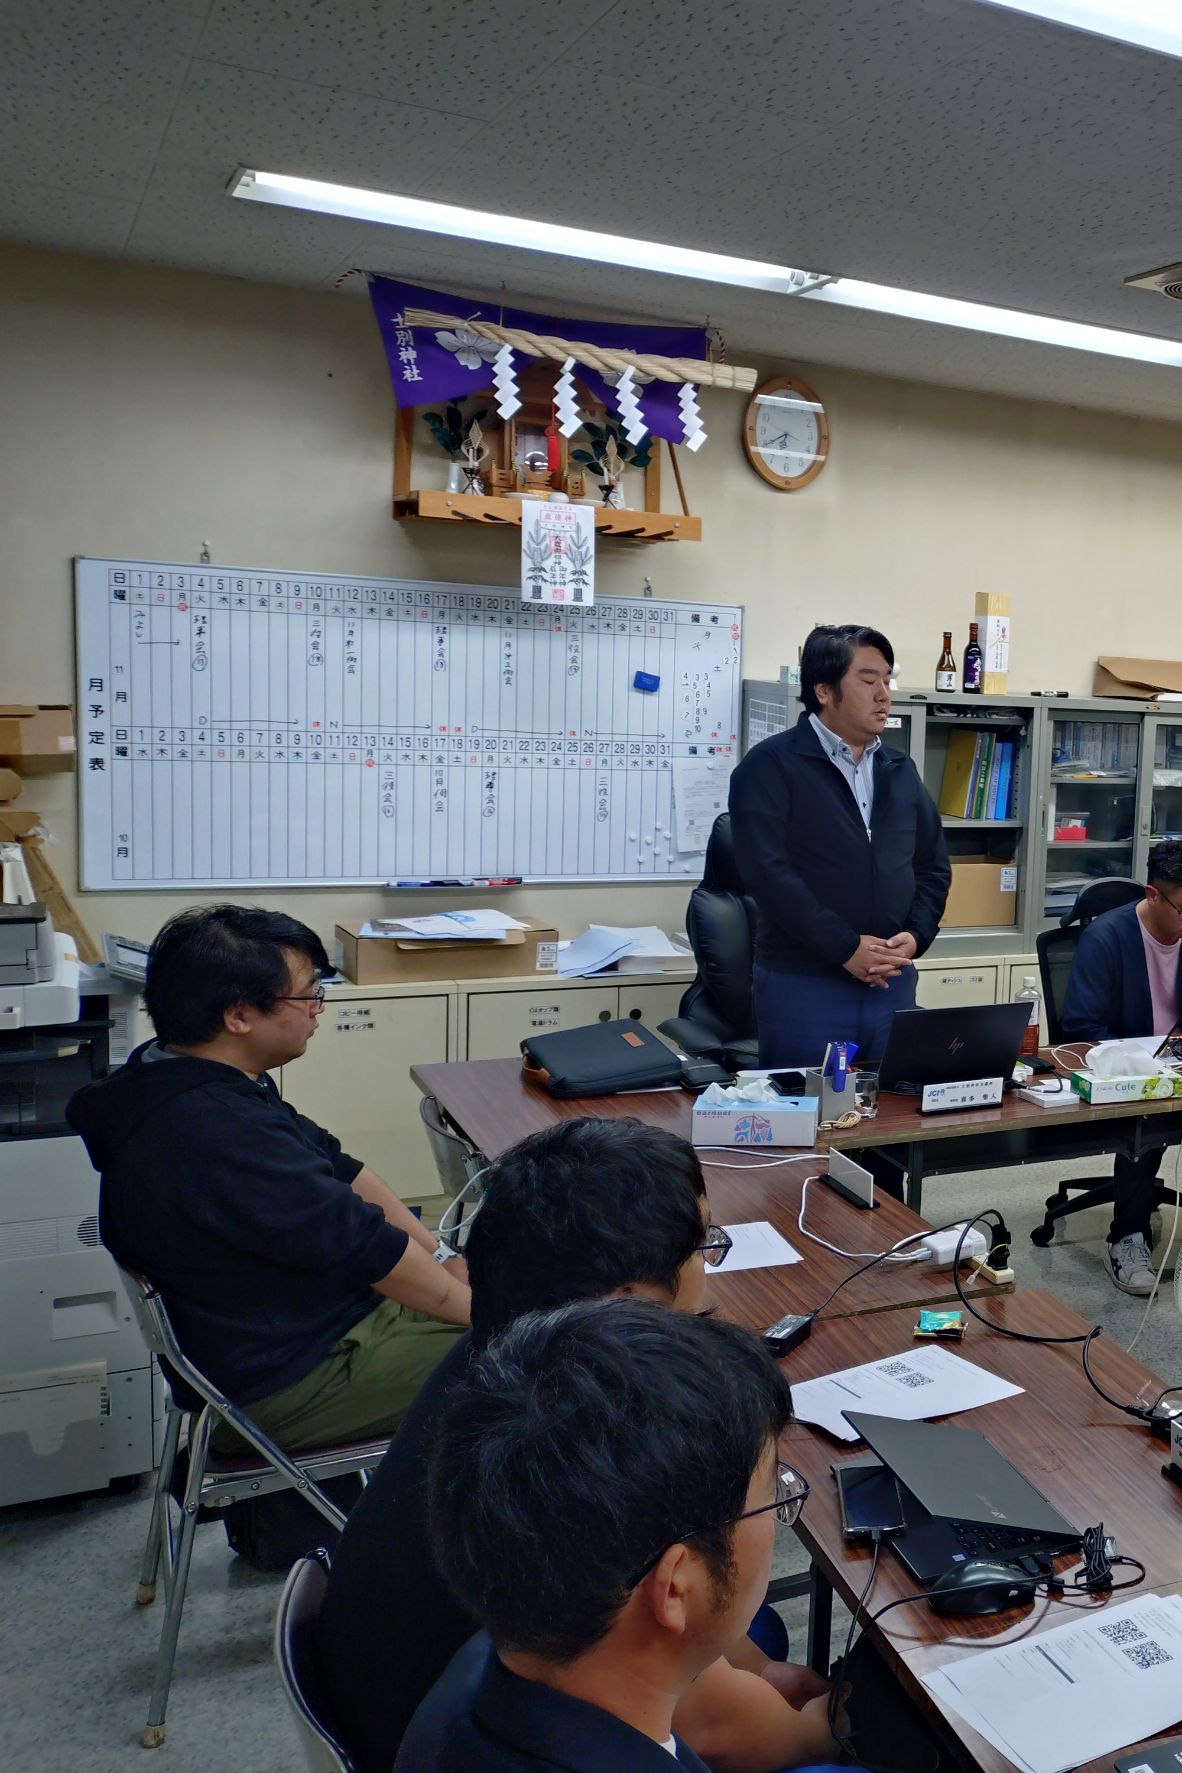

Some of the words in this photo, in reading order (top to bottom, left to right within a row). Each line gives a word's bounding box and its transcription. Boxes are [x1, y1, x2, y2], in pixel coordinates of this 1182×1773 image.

[114, 572, 126, 584] 日
[310, 586, 323, 597] 10
[329, 587, 340, 598] 11
[347, 589, 359, 600] 12
[365, 590, 377, 601] 13
[383, 591, 394, 601] 14
[400, 592, 413, 603] 15
[418, 593, 430, 605] 16
[436, 595, 447, 605] 17
[453, 596, 464, 607] 18
[471, 597, 482, 608] 19
[487, 598, 499, 609] 20
[504, 600, 515, 610] 21
[586, 606, 597, 616] 26
[601, 607, 612, 617] 27
[617, 608, 628, 619] 28
[633, 609, 643, 620] 29
[648, 610, 658, 621] 30
[663, 611, 673, 622] 31
[115, 691, 128, 703] 月
[88, 678, 106, 771] 月予定表
[115, 729, 127, 740] 日
[310, 734, 322, 745] 10
[329, 735, 340, 746] 11
[347, 736, 358, 746] 12
[365, 736, 376, 747] 13
[382, 737, 394, 746] 14
[400, 737, 411, 748] 15
[417, 738, 429, 748] 16
[434, 738, 446, 748] 17
[453, 739, 463, 749] 18
[469, 739, 480, 750] 19
[485, 739, 497, 750] 20
[502, 740, 513, 750] 21
[519, 741, 530, 751] 22
[535, 741, 546, 751] 23
[551, 742, 562, 751] 24
[567, 742, 578, 752] 25
[583, 743, 594, 753] 26
[599, 743, 610, 753] 27
[615, 744, 625, 754] 28
[630, 744, 640, 754] 29
[645, 745, 655, 755] 30
[660, 745, 670, 755] 31
[116, 847, 129, 859] 月
